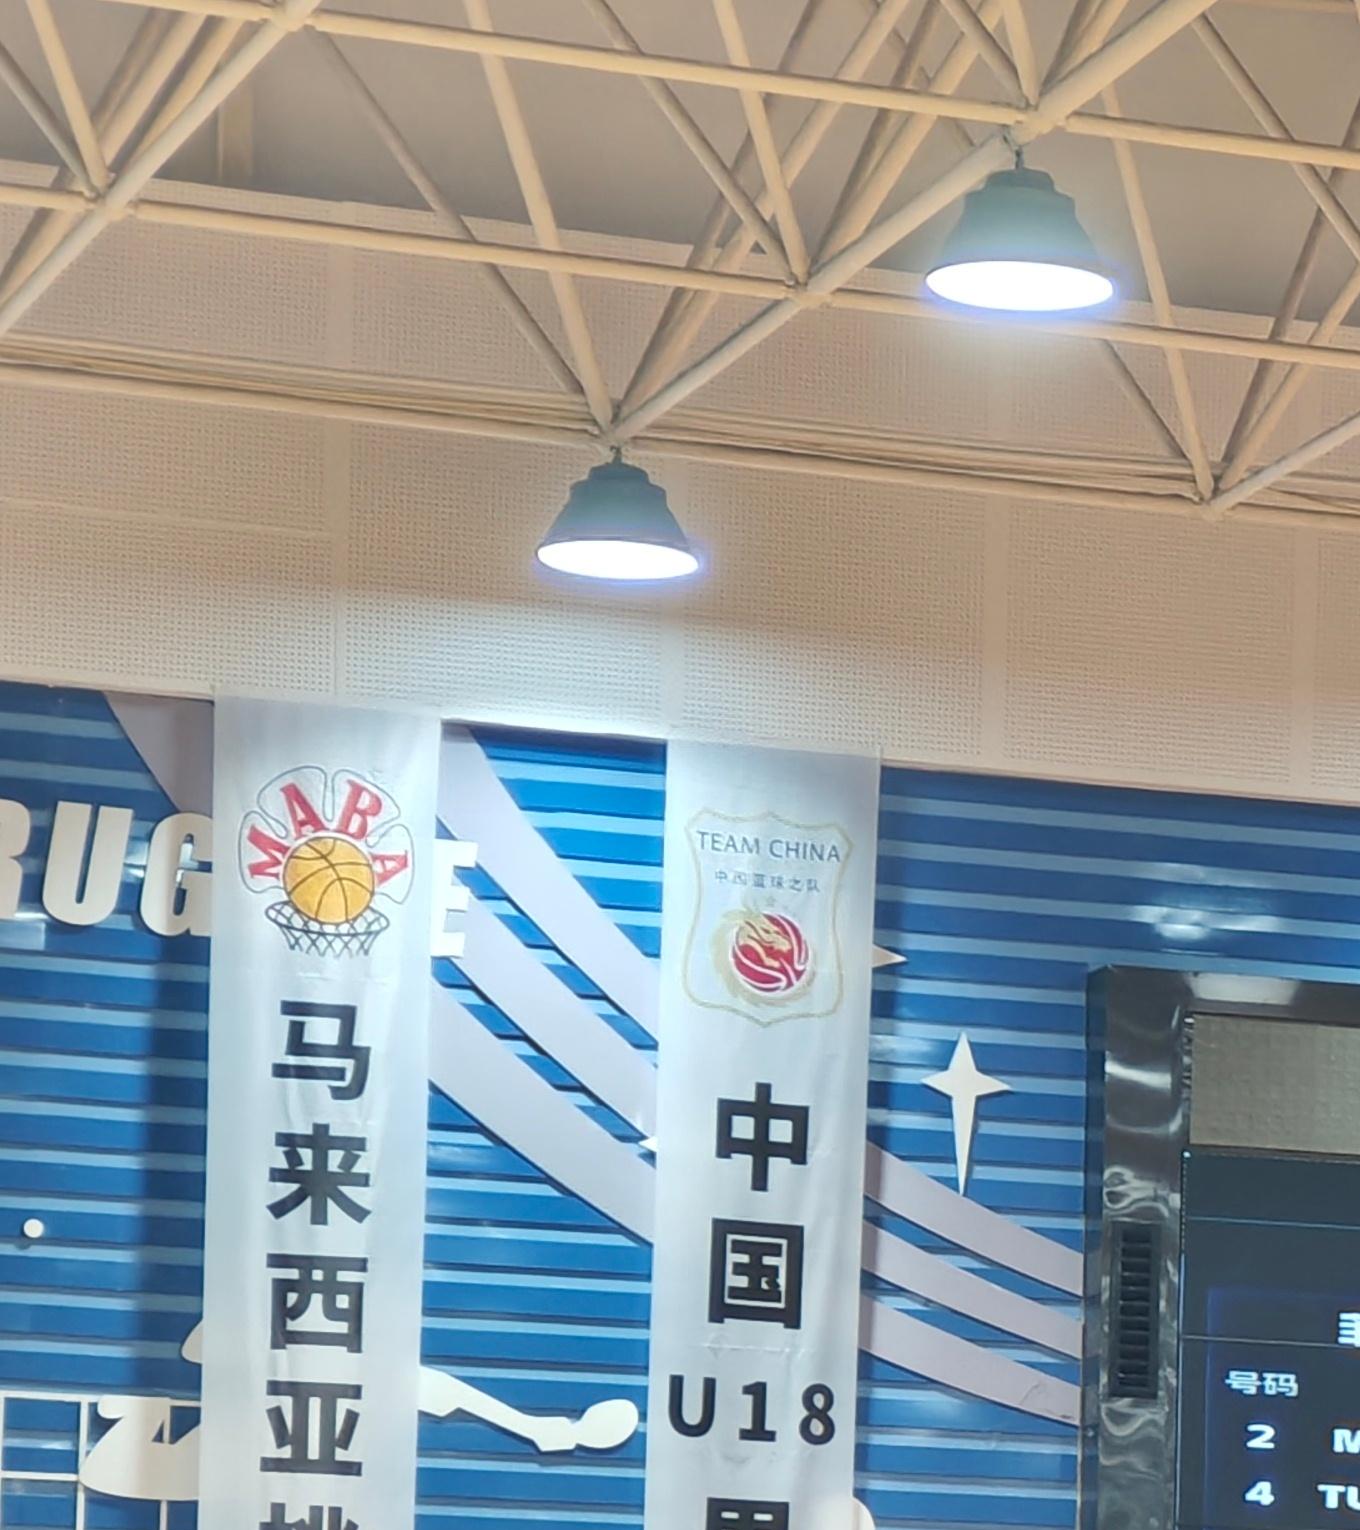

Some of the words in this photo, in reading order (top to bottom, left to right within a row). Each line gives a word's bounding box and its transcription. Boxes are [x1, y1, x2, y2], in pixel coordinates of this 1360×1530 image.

[697, 830, 760, 855] TEAM
[769, 839, 841, 862] CHINA
[1225, 1371, 1298, 1396] 号码
[1247, 1424, 1275, 1448] 2
[1245, 1481, 1274, 1505] 4
